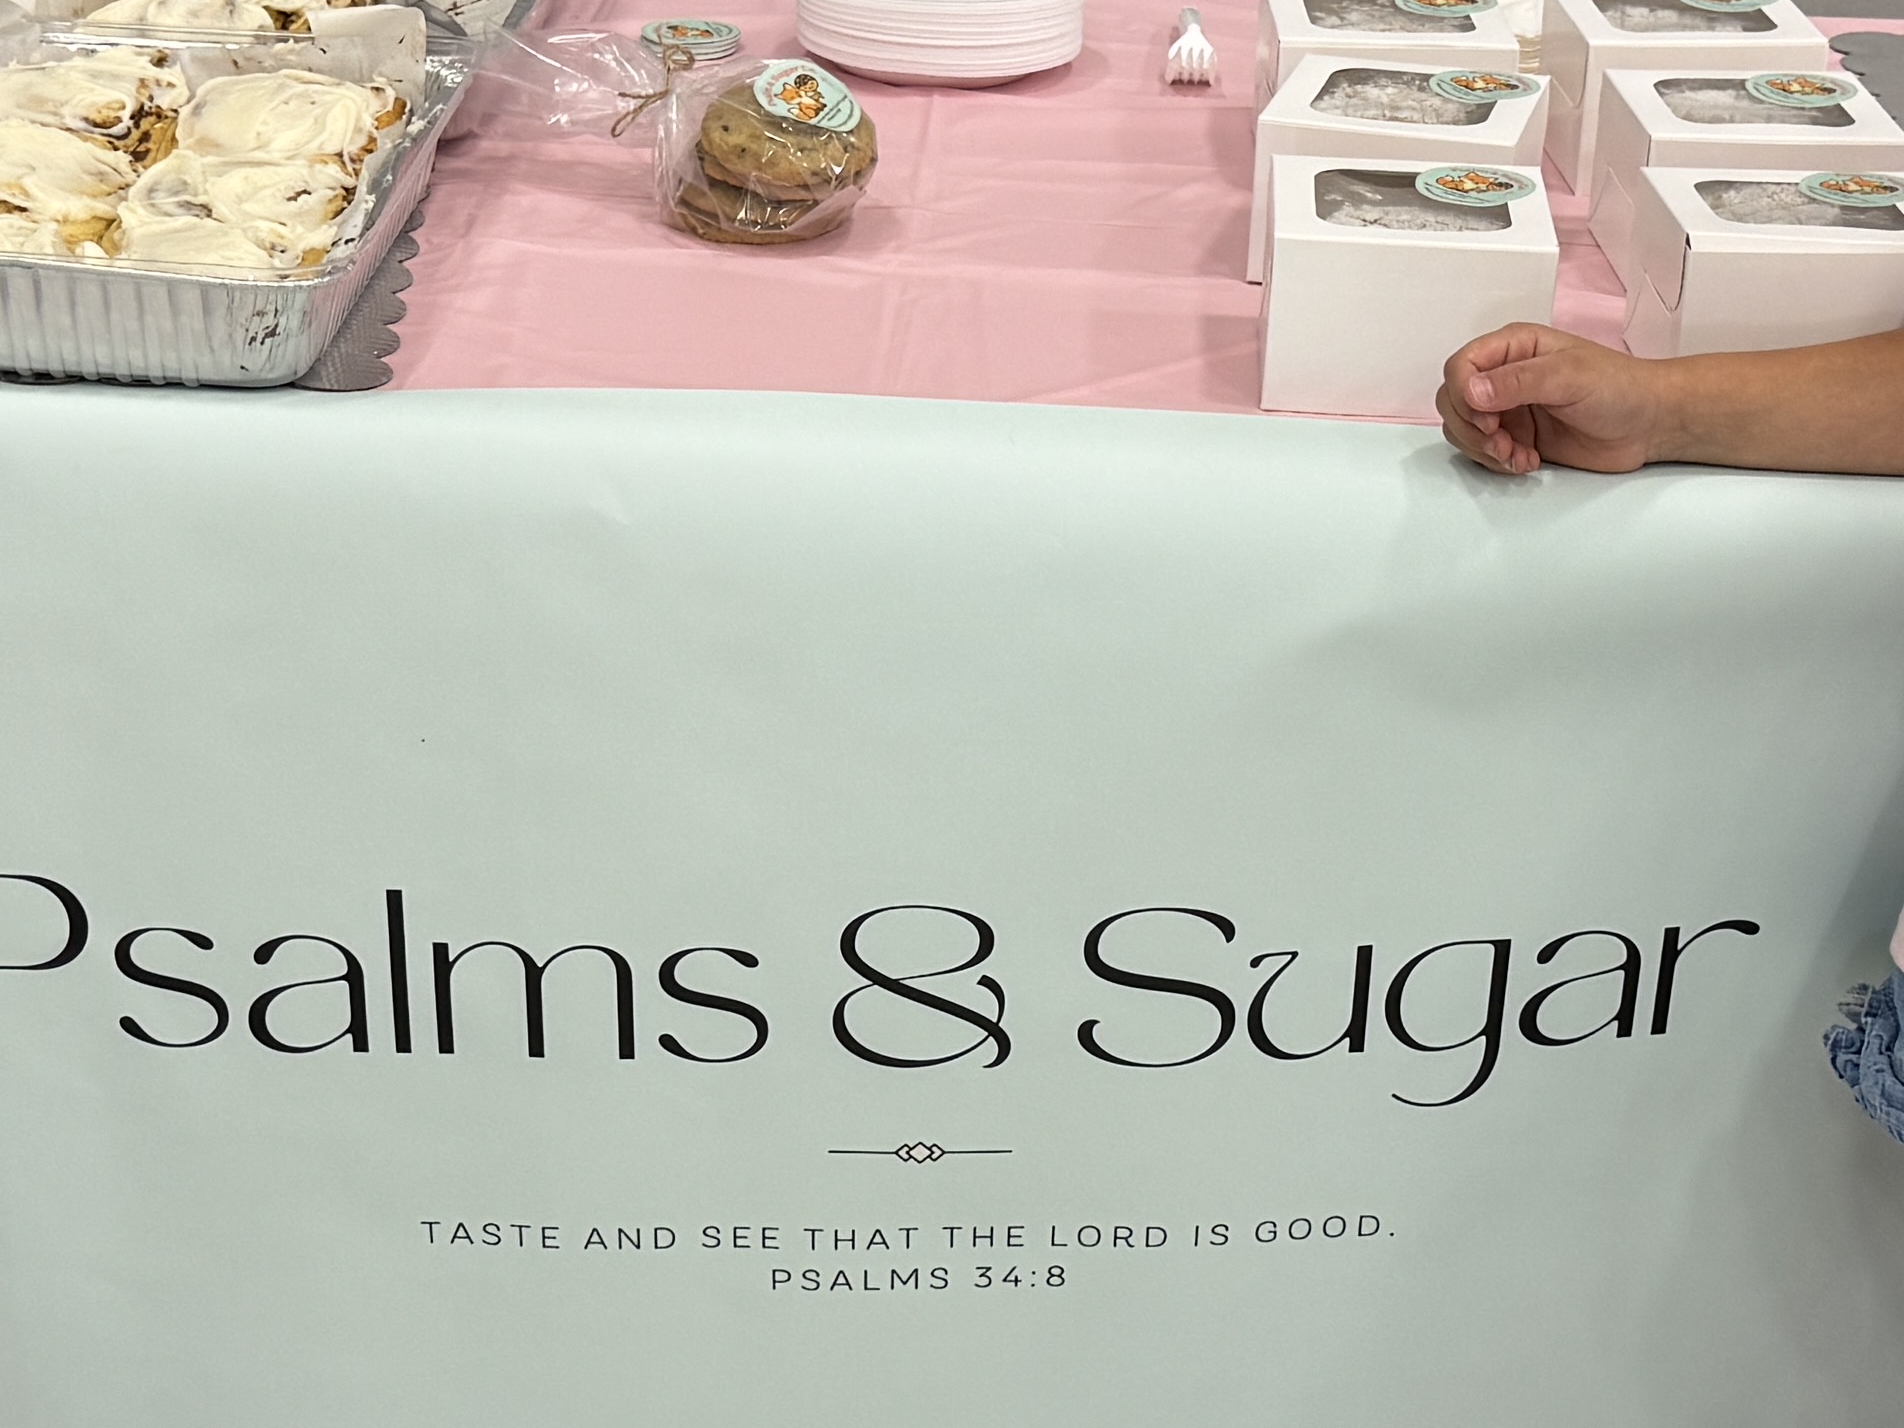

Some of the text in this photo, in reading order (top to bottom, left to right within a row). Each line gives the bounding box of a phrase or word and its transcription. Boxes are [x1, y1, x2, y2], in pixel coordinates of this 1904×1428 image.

[830, 903, 1013, 1070] &
[1075, 905, 1762, 1109] Sugar
[419, 1214, 1396, 1252] TASTE AND SEE THAT THE LORD IS GOOD.
[771, 1264, 1067, 1292] PSALMS 34:8
